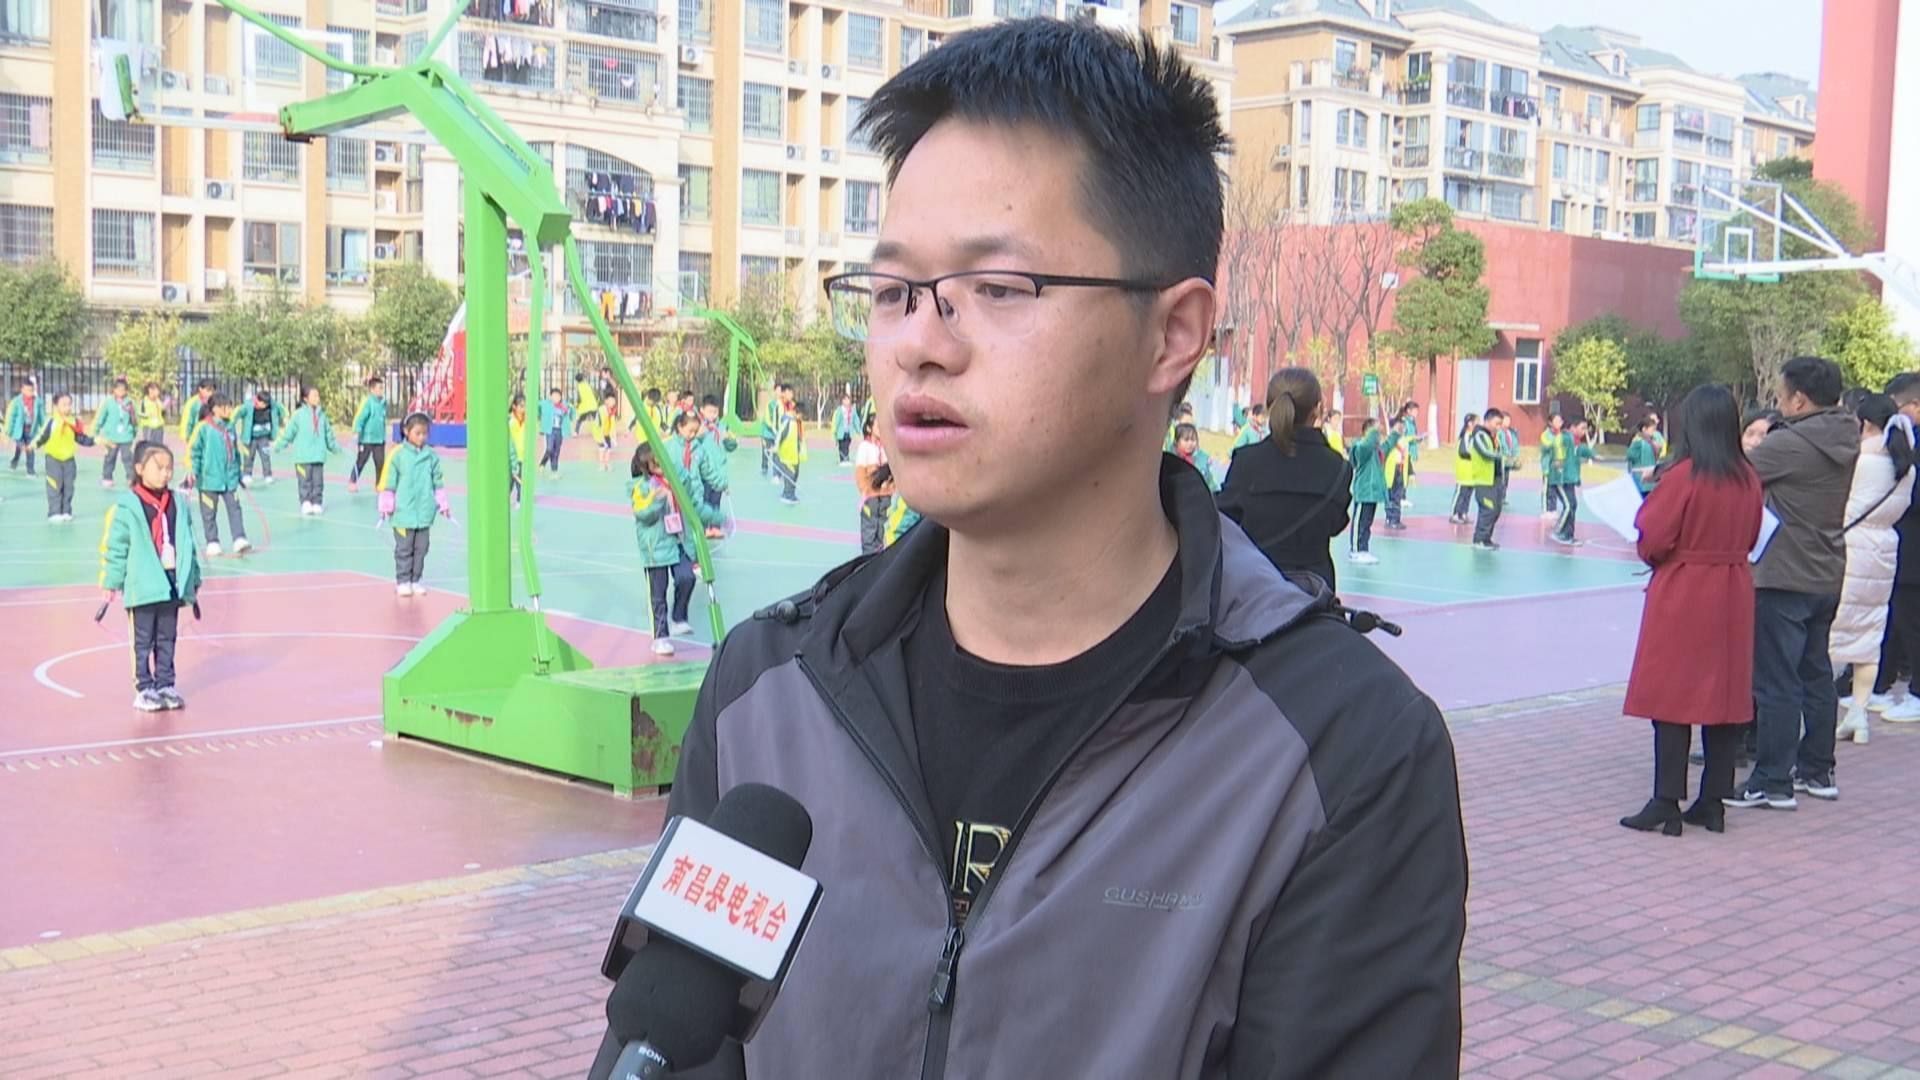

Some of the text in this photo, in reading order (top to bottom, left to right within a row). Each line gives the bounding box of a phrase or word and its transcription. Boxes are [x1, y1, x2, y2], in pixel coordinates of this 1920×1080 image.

[662, 855, 787, 942] 南昌县电视台
[638, 1046, 668, 1067] SONY
